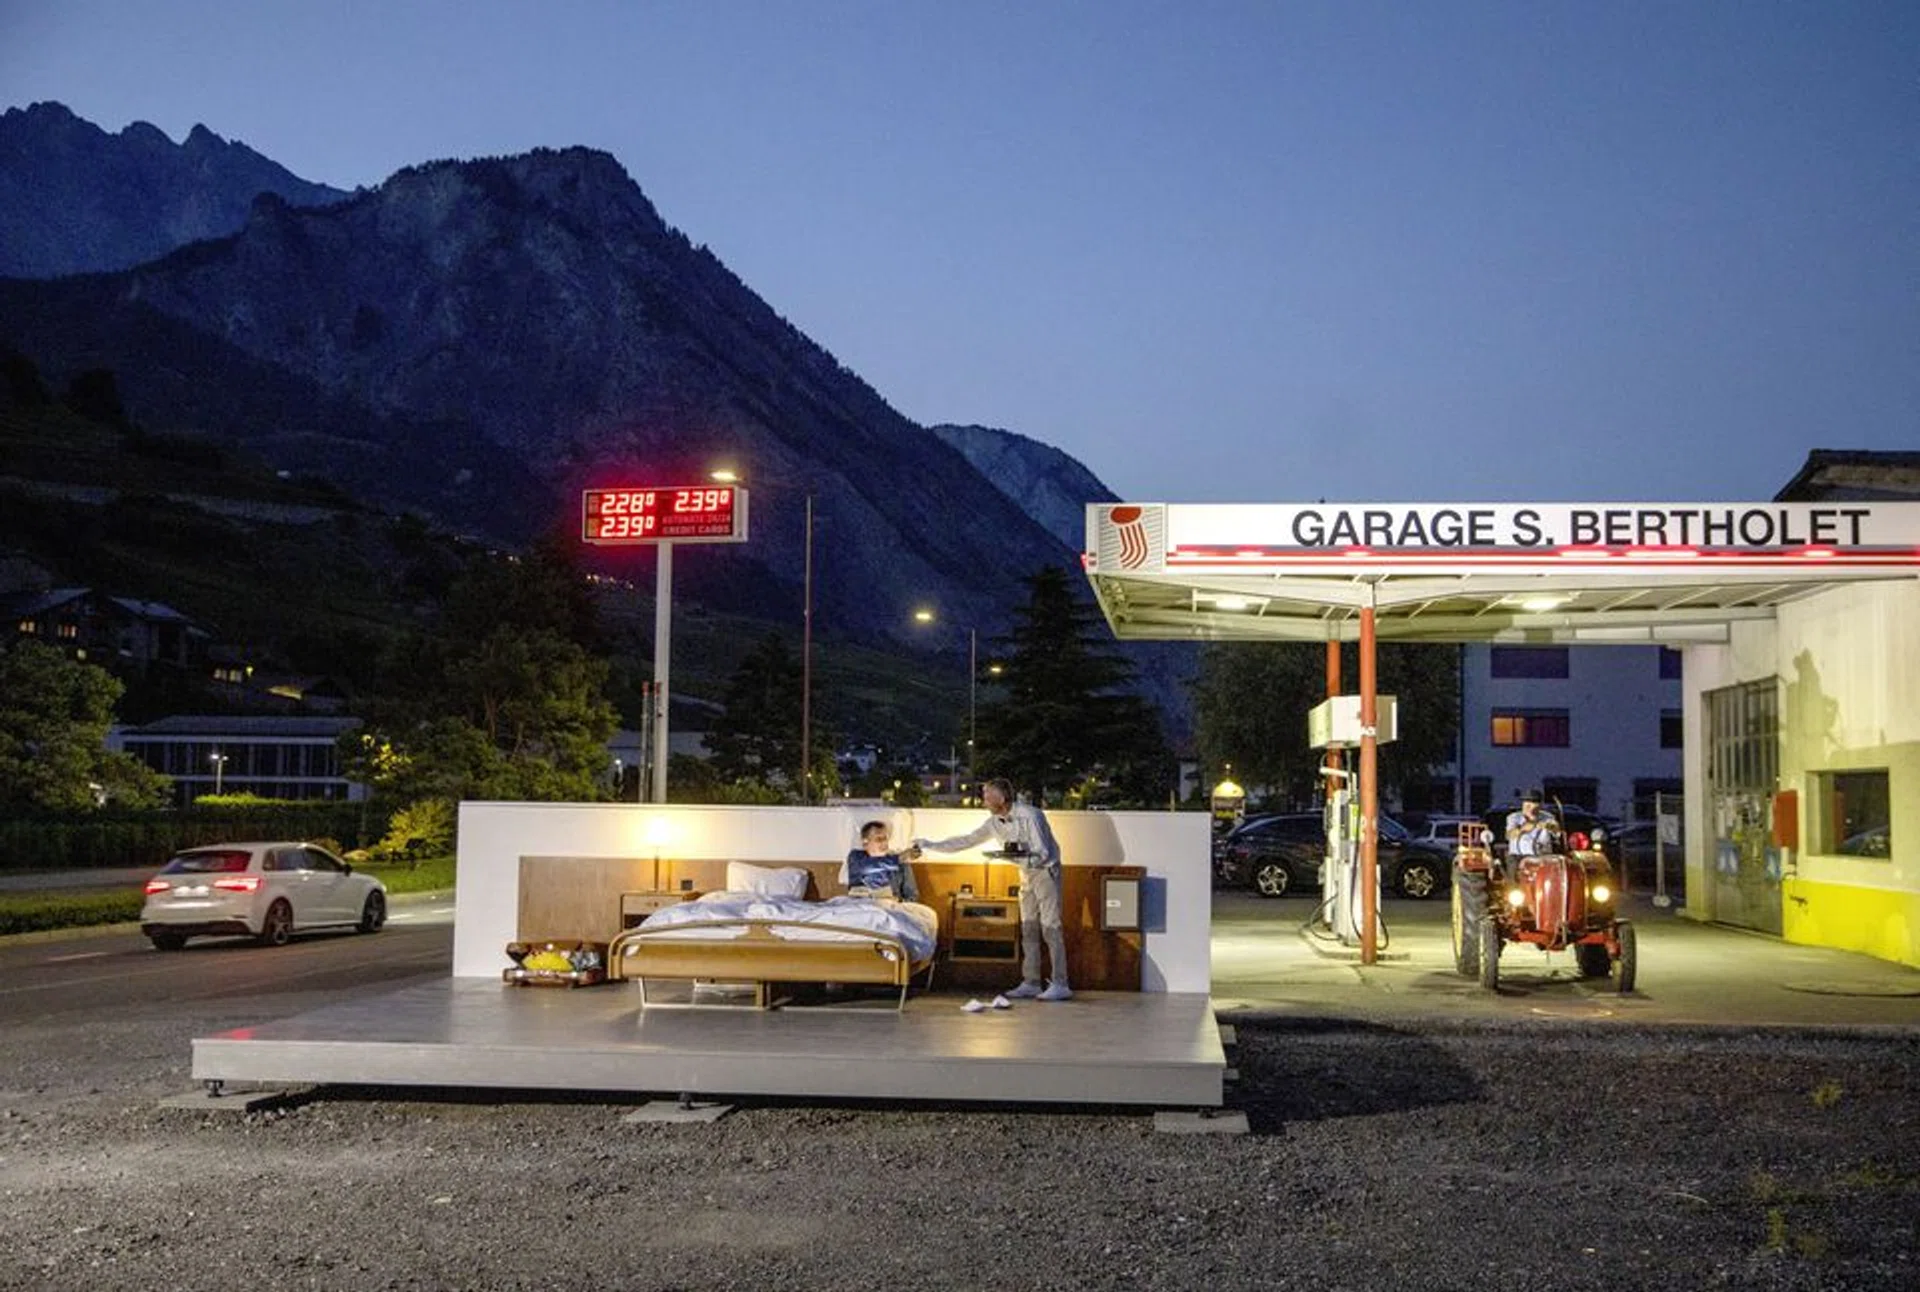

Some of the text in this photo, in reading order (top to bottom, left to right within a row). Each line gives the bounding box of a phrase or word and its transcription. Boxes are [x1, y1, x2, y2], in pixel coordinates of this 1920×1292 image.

[698, 524, 731, 534] CARDS
[1292, 509, 1871, 547] GARAGE S. BERTHOLET
